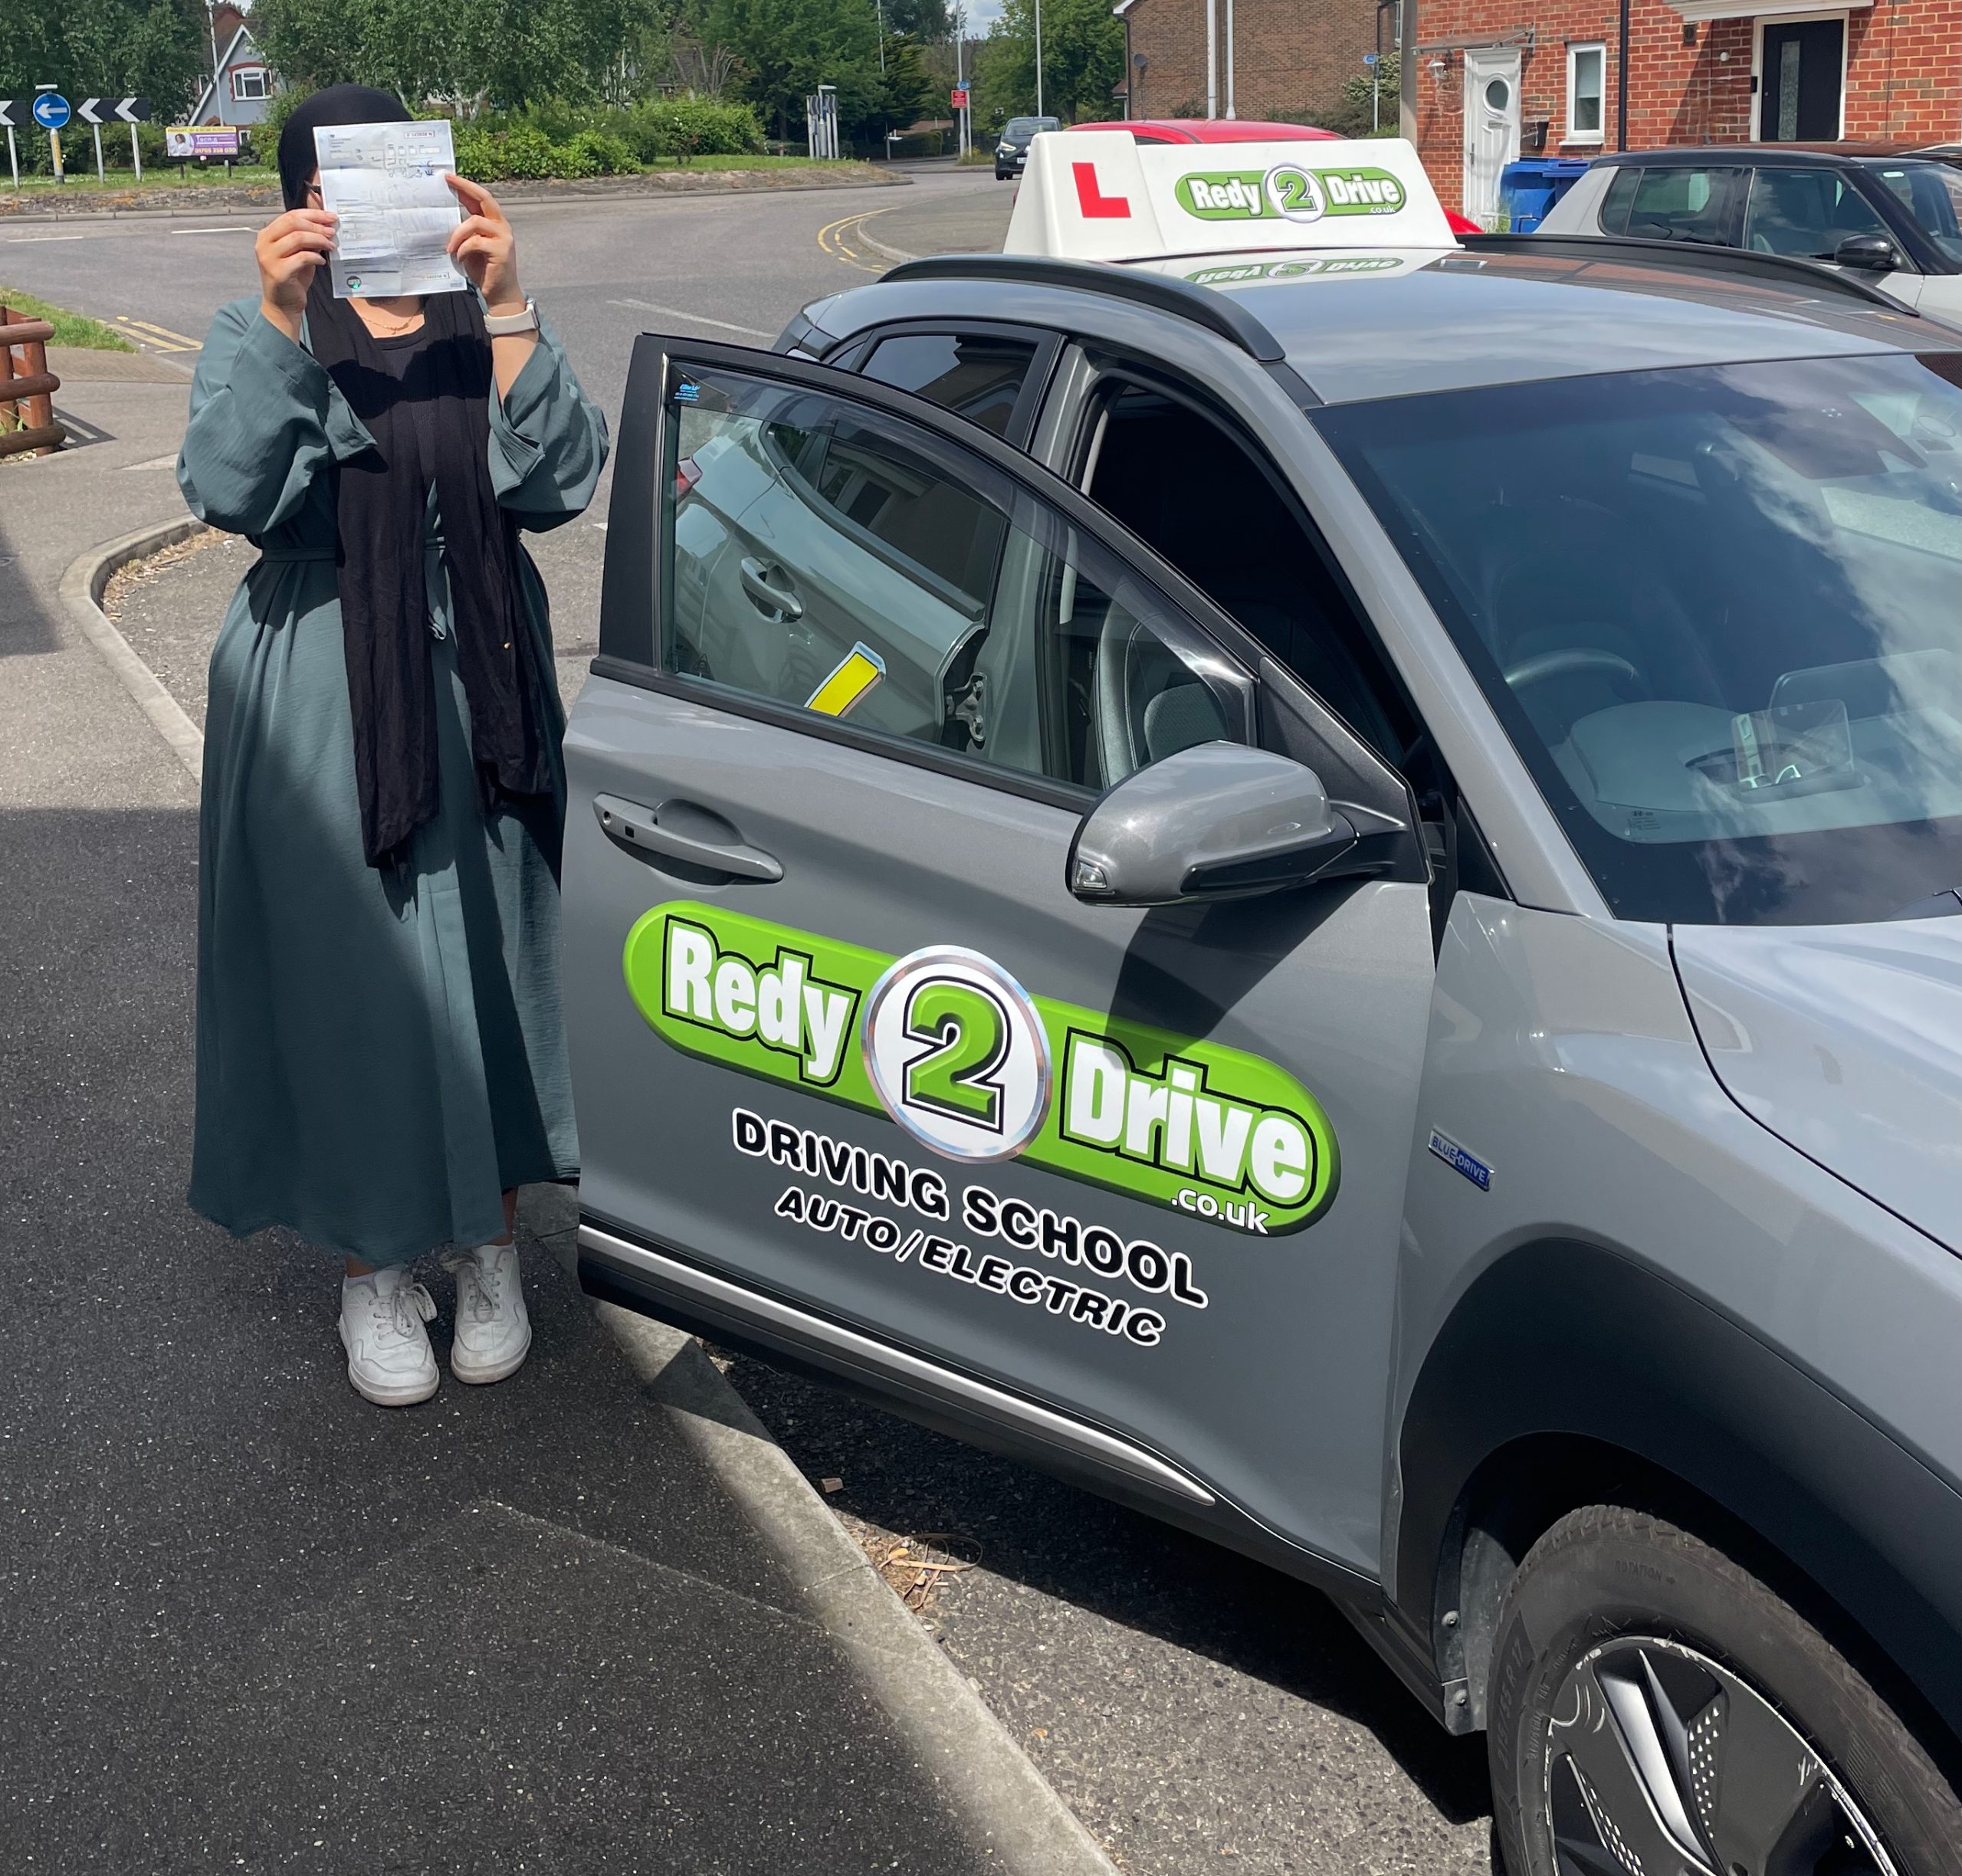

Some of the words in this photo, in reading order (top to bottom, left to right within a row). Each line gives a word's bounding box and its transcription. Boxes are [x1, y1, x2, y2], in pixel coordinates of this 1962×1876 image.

[1072, 162, 1131, 218] L
[1186, 178, 1262, 215] Redy
[1275, 170, 1317, 212] 2
[1323, 173, 1401, 205] Drive
[665, 918, 858, 1084] Redy
[903, 976, 1006, 1135] 2
[1062, 1030, 1315, 1206] Drive
[732, 1107, 950, 1222] DRIVING
[963, 1185, 1209, 1310] SCHOOL
[1171, 1189, 1270, 1235] .co.uk
